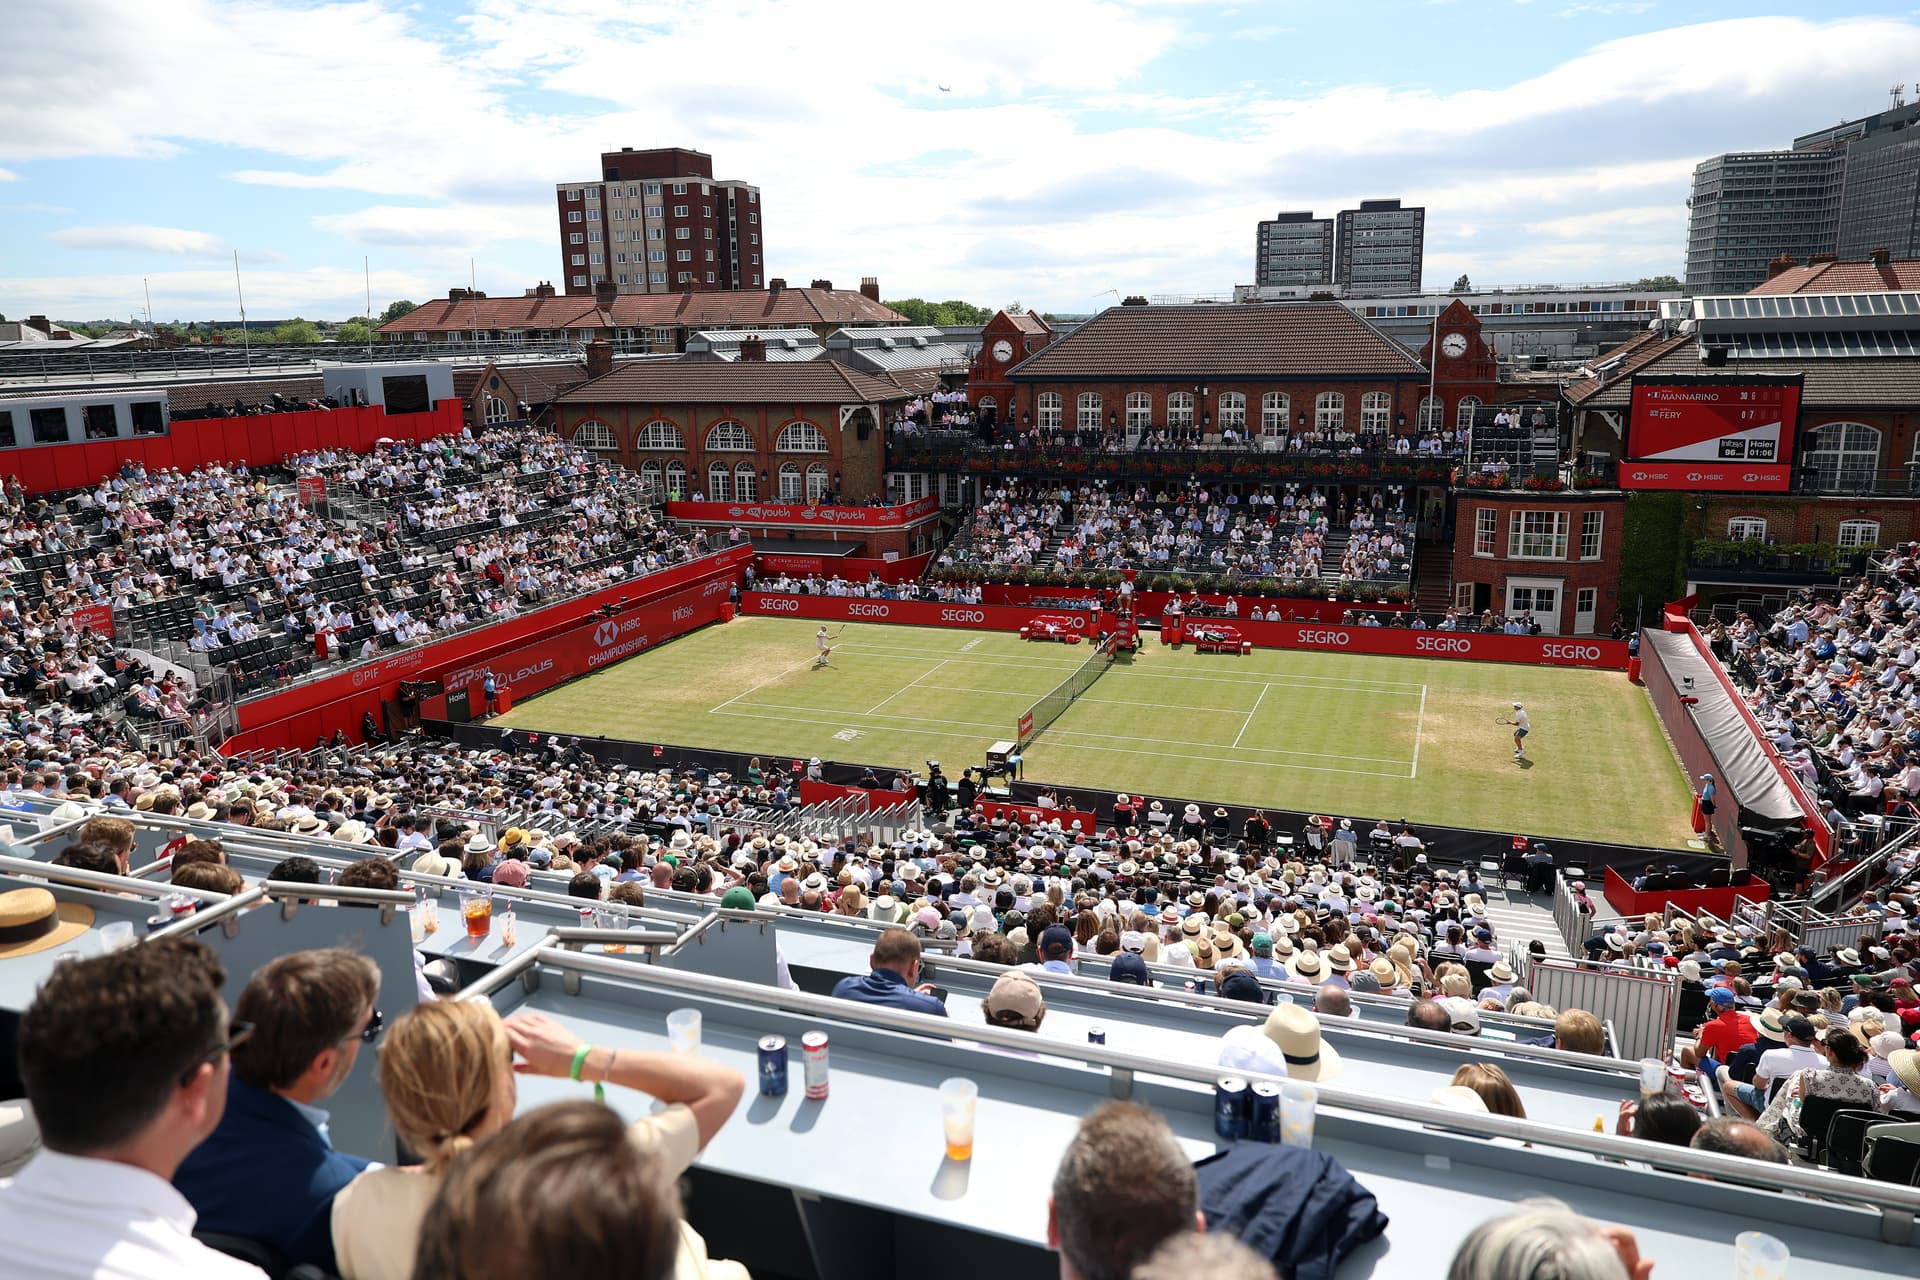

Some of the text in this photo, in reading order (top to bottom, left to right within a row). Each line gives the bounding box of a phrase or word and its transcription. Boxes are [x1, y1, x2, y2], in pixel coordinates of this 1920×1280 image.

[1659, 411, 1682, 419] FERY
[1750, 440, 1773, 448] Haier
[1703, 473, 1724, 481] HSBC
[761, 507, 791, 520] youth
[835, 510, 866, 521] youth
[760, 598, 799, 611] SEGRO
[848, 603, 889, 617] SEGRO
[941, 609, 984, 623] SEGRO
[620, 617, 641, 633] HSBC
[1297, 629, 1350, 646] SEGRO
[1416, 635, 1472, 653] SEGRO
[588, 634, 648, 667] CHAMPIONSHIPS
[1542, 643, 1601, 661] SEGRO
[363, 667, 379, 682] PIF
[509, 658, 553, 683] LEXUS
[446, 669, 475, 691] ATP
